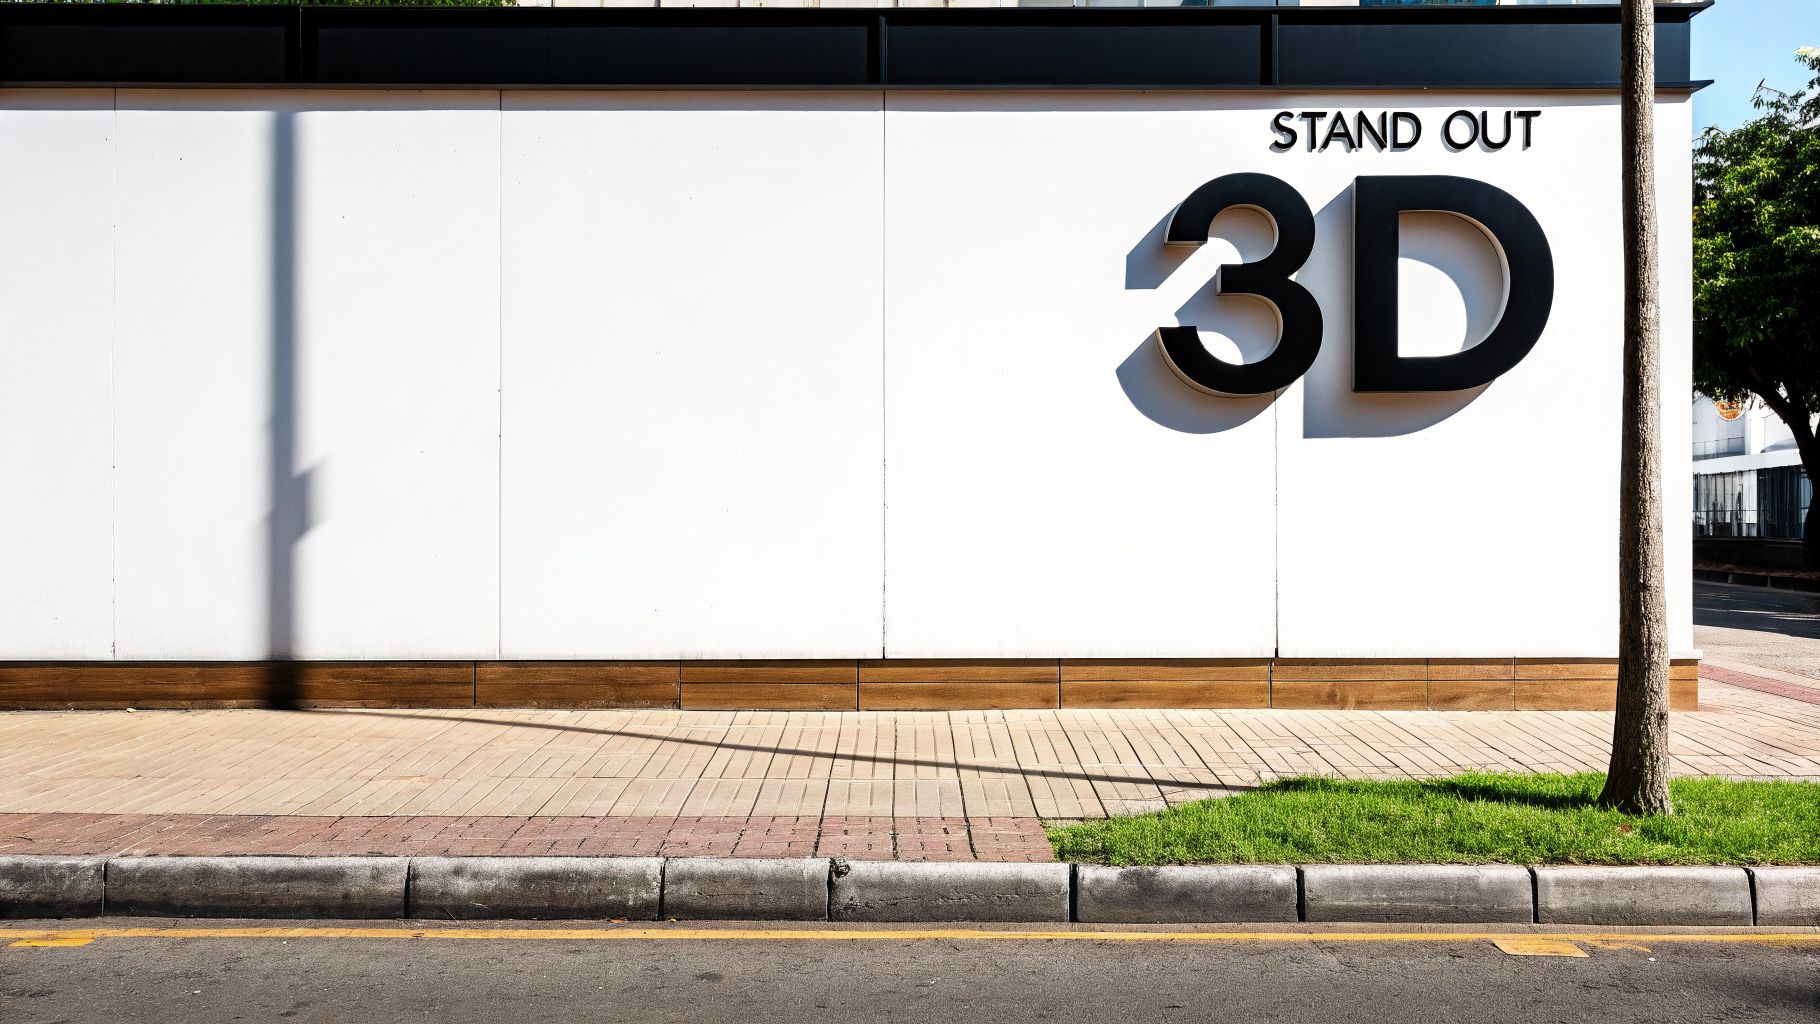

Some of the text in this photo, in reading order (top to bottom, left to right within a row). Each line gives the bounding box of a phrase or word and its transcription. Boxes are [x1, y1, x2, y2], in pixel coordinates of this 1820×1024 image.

[1272, 109, 1542, 152] STAND OUT
[1156, 172, 1554, 396] 3D
